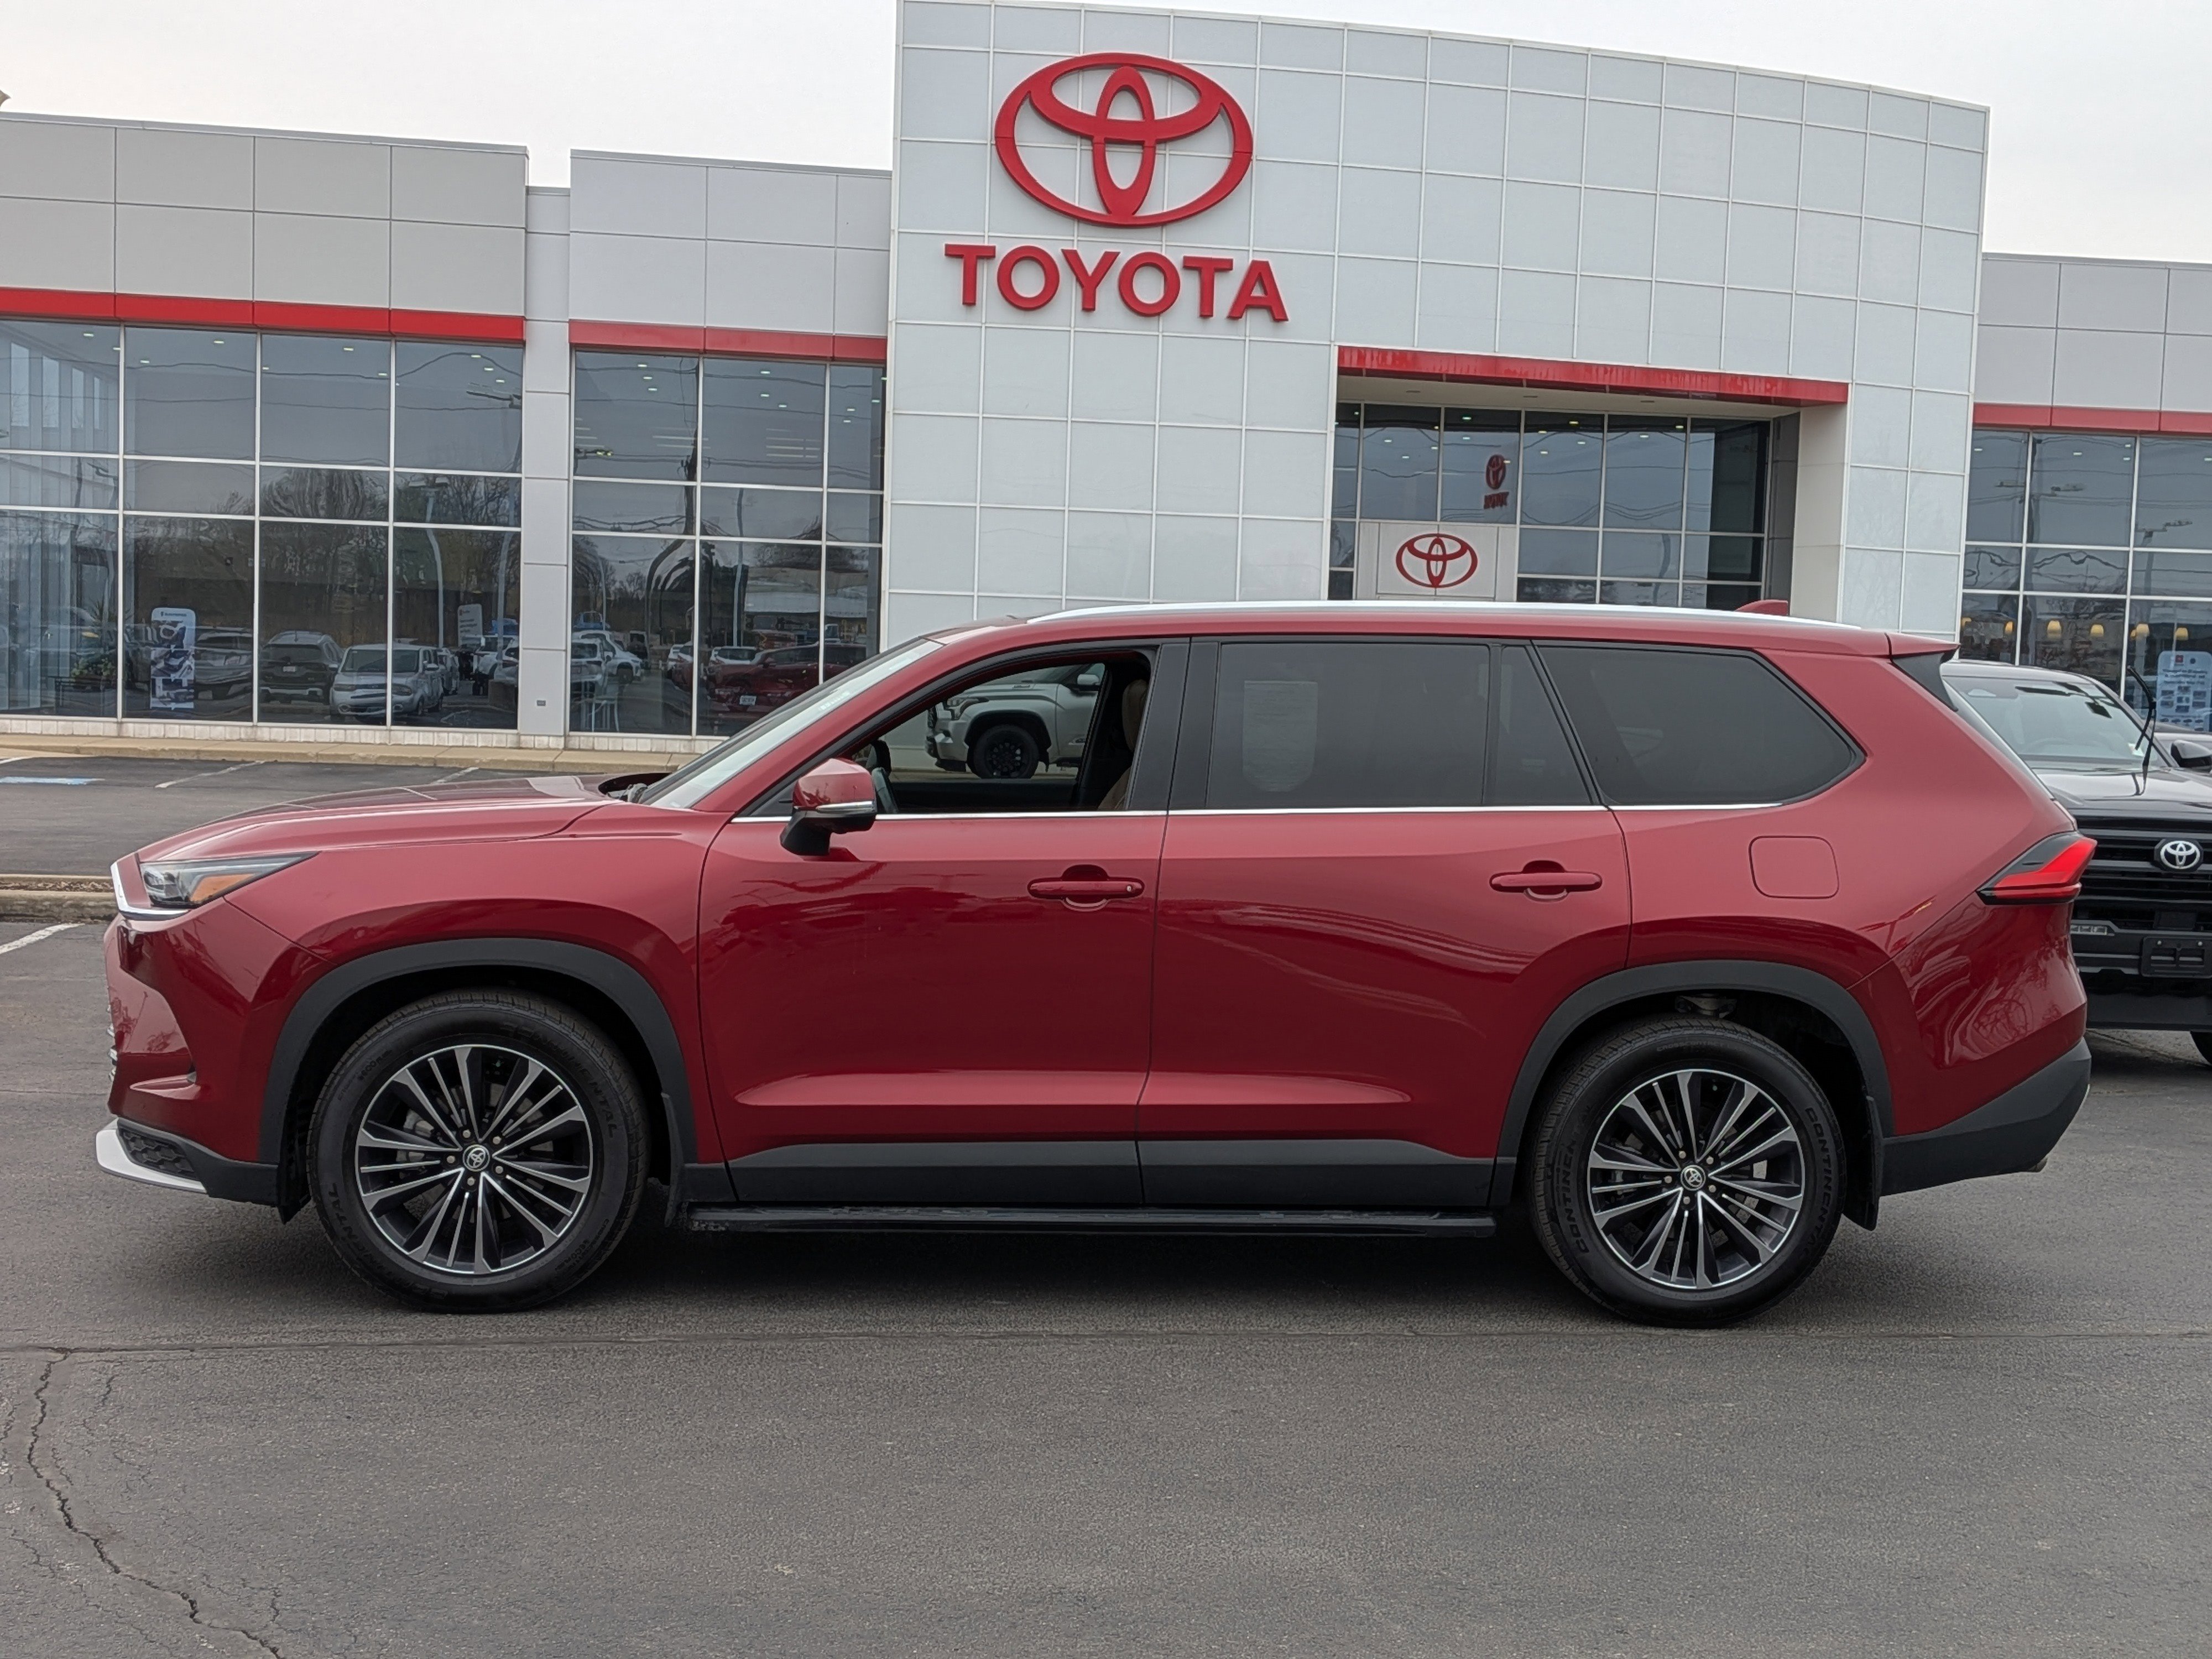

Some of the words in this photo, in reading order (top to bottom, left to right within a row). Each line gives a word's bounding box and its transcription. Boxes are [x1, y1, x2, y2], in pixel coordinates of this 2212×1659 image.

[944, 243, 1289, 322] TOYOTA
[500, 1021, 617, 1138] COINENTAL
[1562, 1104, 1593, 1254] CONTINENAL
[1801, 1107, 1832, 1260] CONTINENTAL
